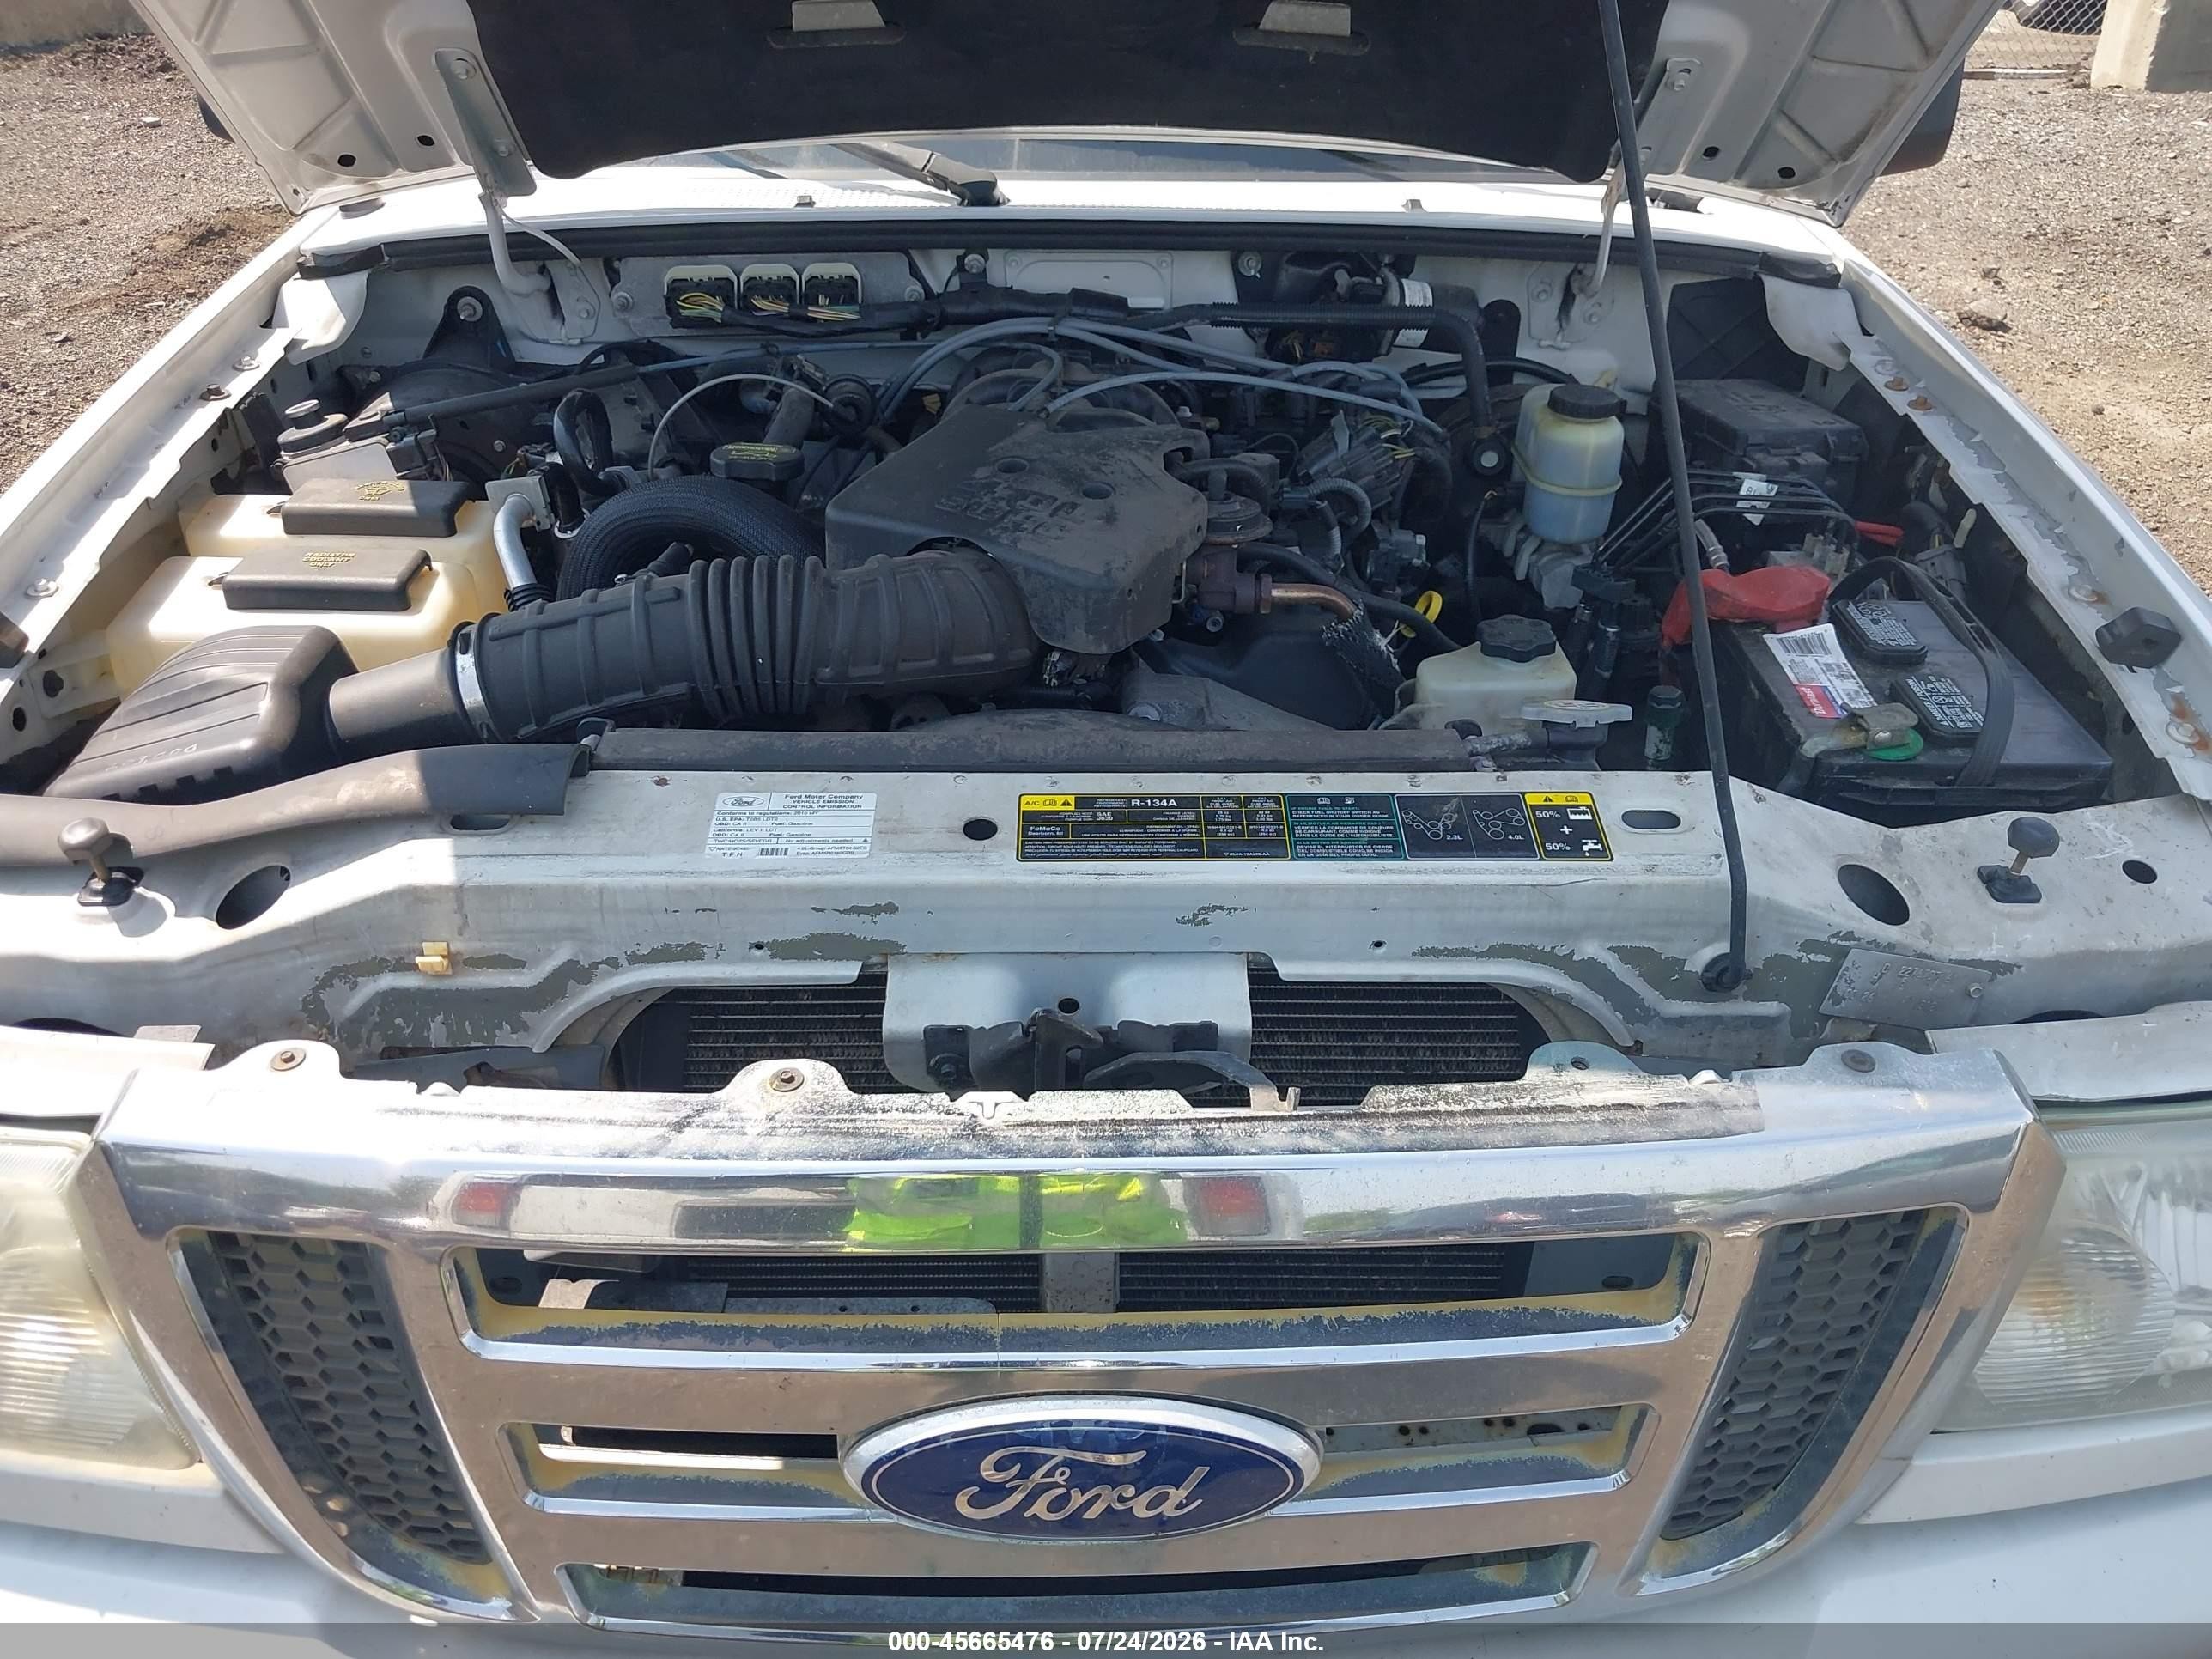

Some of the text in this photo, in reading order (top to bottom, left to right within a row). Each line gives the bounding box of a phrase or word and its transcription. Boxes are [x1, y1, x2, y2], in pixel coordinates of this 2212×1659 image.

[1131, 799, 1177, 807] R-134A
[1545, 842, 1571, 851] 50%
[955, 1445, 1210, 1522] Ford
